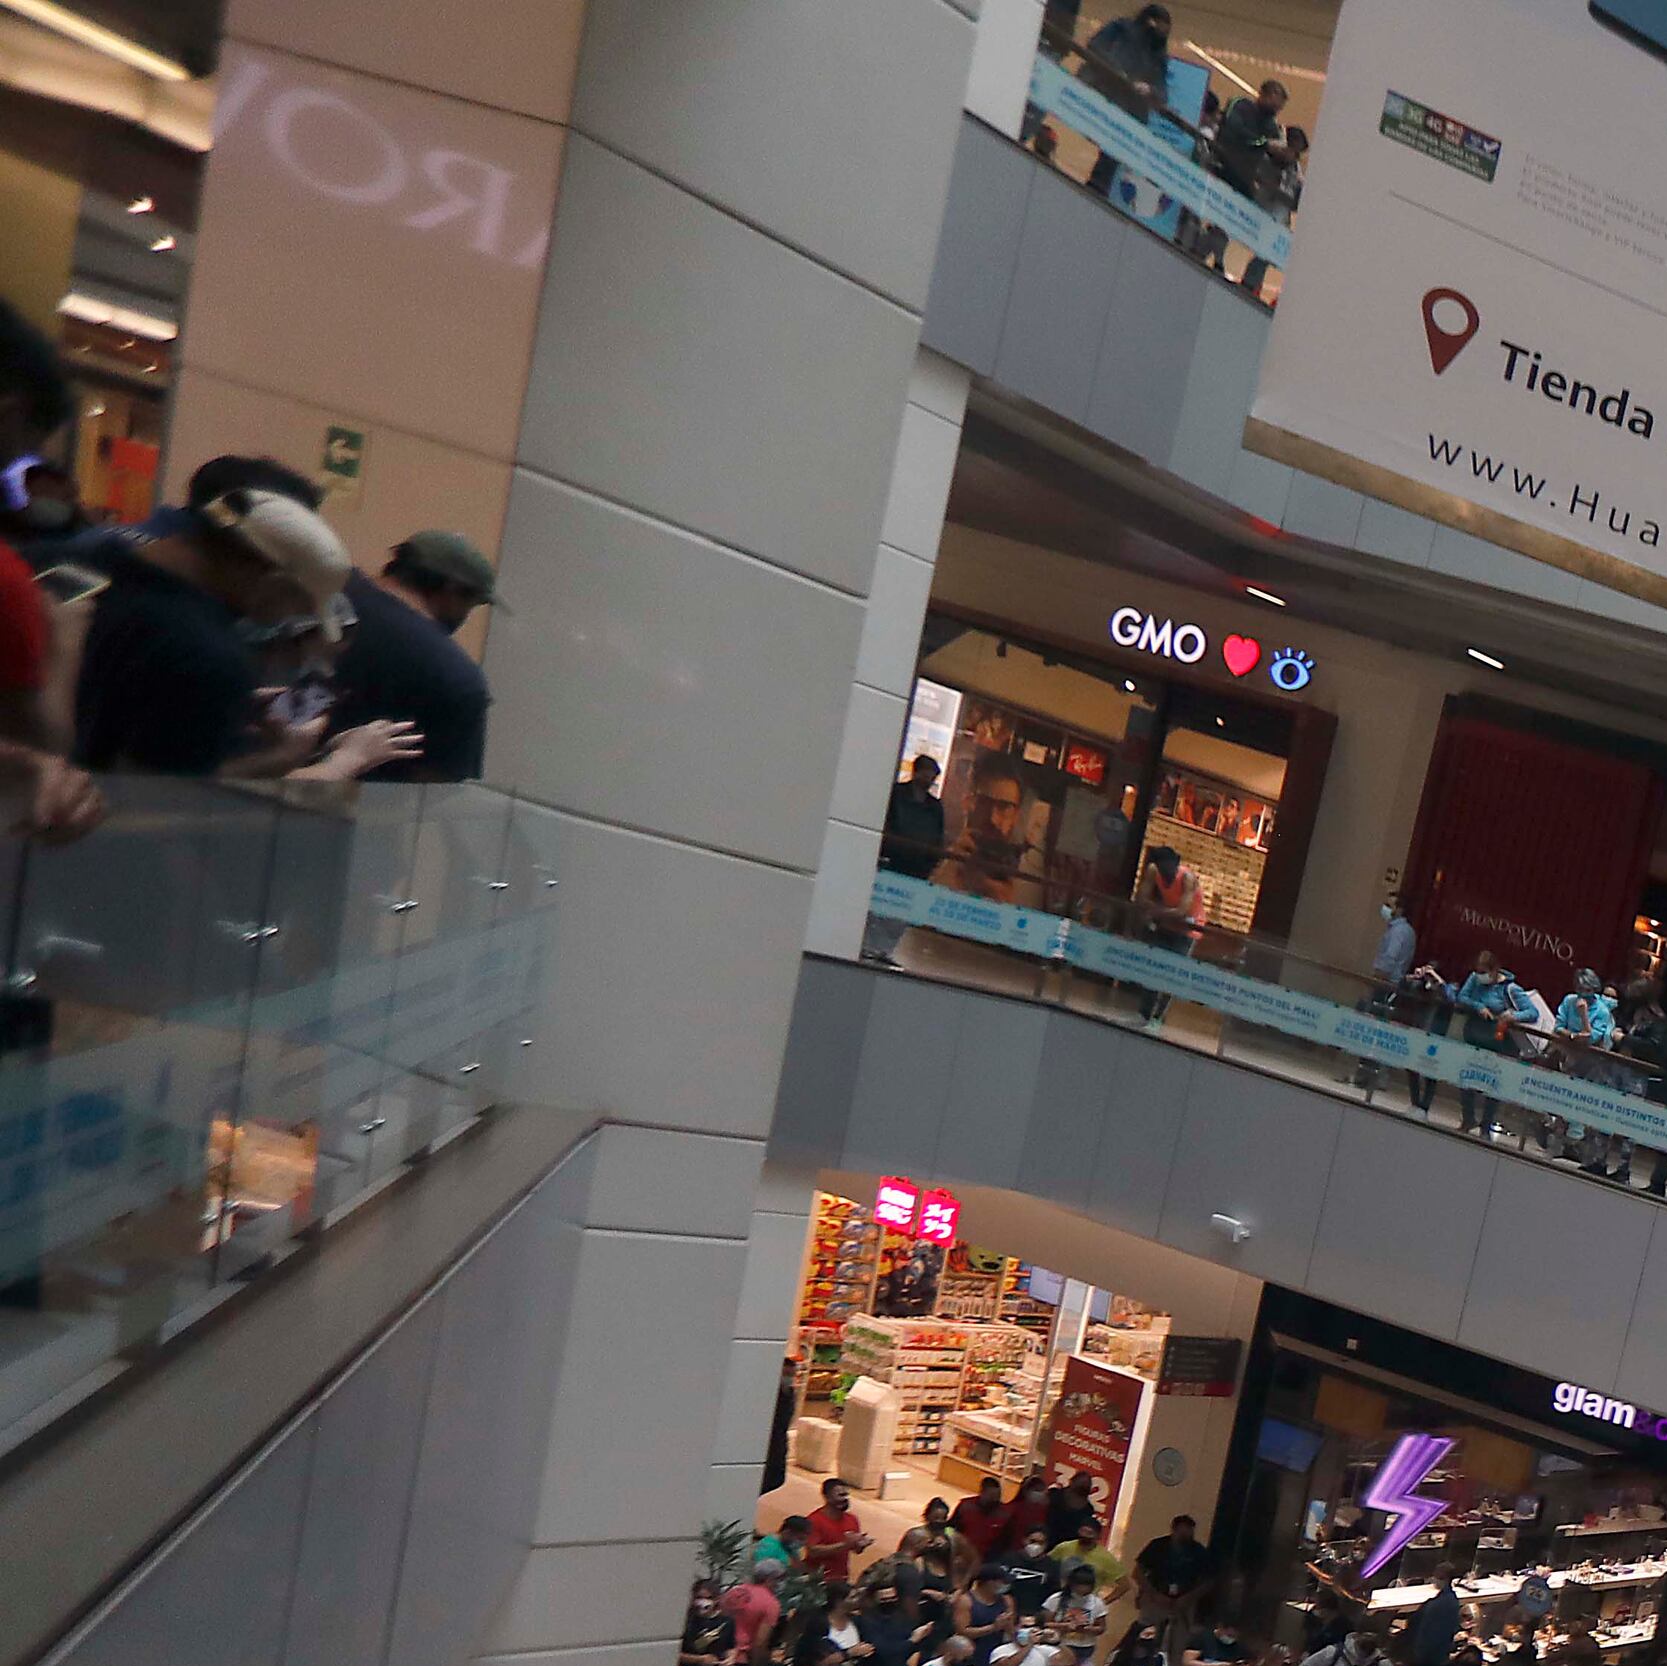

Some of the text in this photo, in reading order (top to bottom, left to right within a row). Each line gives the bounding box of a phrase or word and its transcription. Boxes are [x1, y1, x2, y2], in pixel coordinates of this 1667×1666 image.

[1499, 341, 1655, 439] Tienda
[1110, 606, 1207, 665] GMO
[1601, 1100, 1614, 1112] EN
[1616, 1105, 1665, 1127] DISTINTOS
[1054, 1430, 1125, 1464] DECORATIVAS
